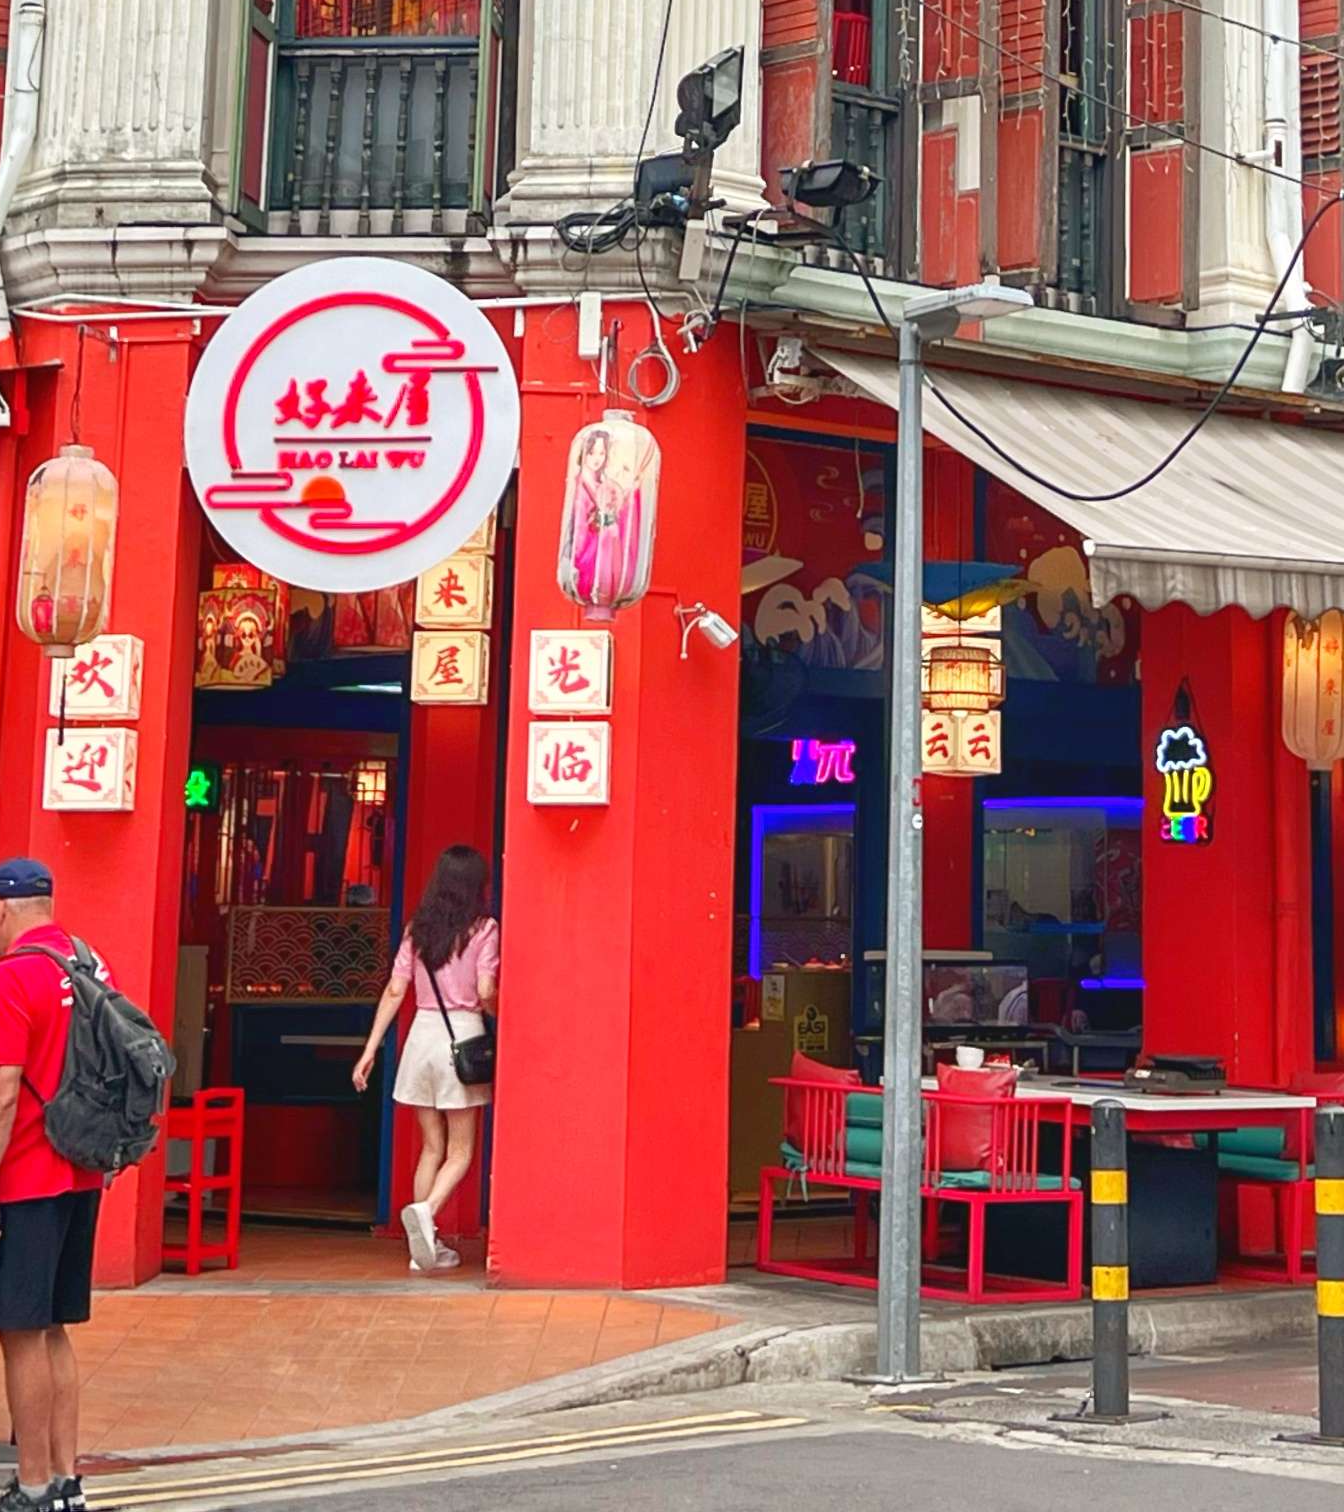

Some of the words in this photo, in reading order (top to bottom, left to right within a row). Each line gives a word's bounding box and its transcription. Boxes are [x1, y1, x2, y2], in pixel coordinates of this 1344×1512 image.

[278, 451, 334, 470] HAO
[337, 451, 379, 470] LAI
[384, 451, 426, 470] WU
